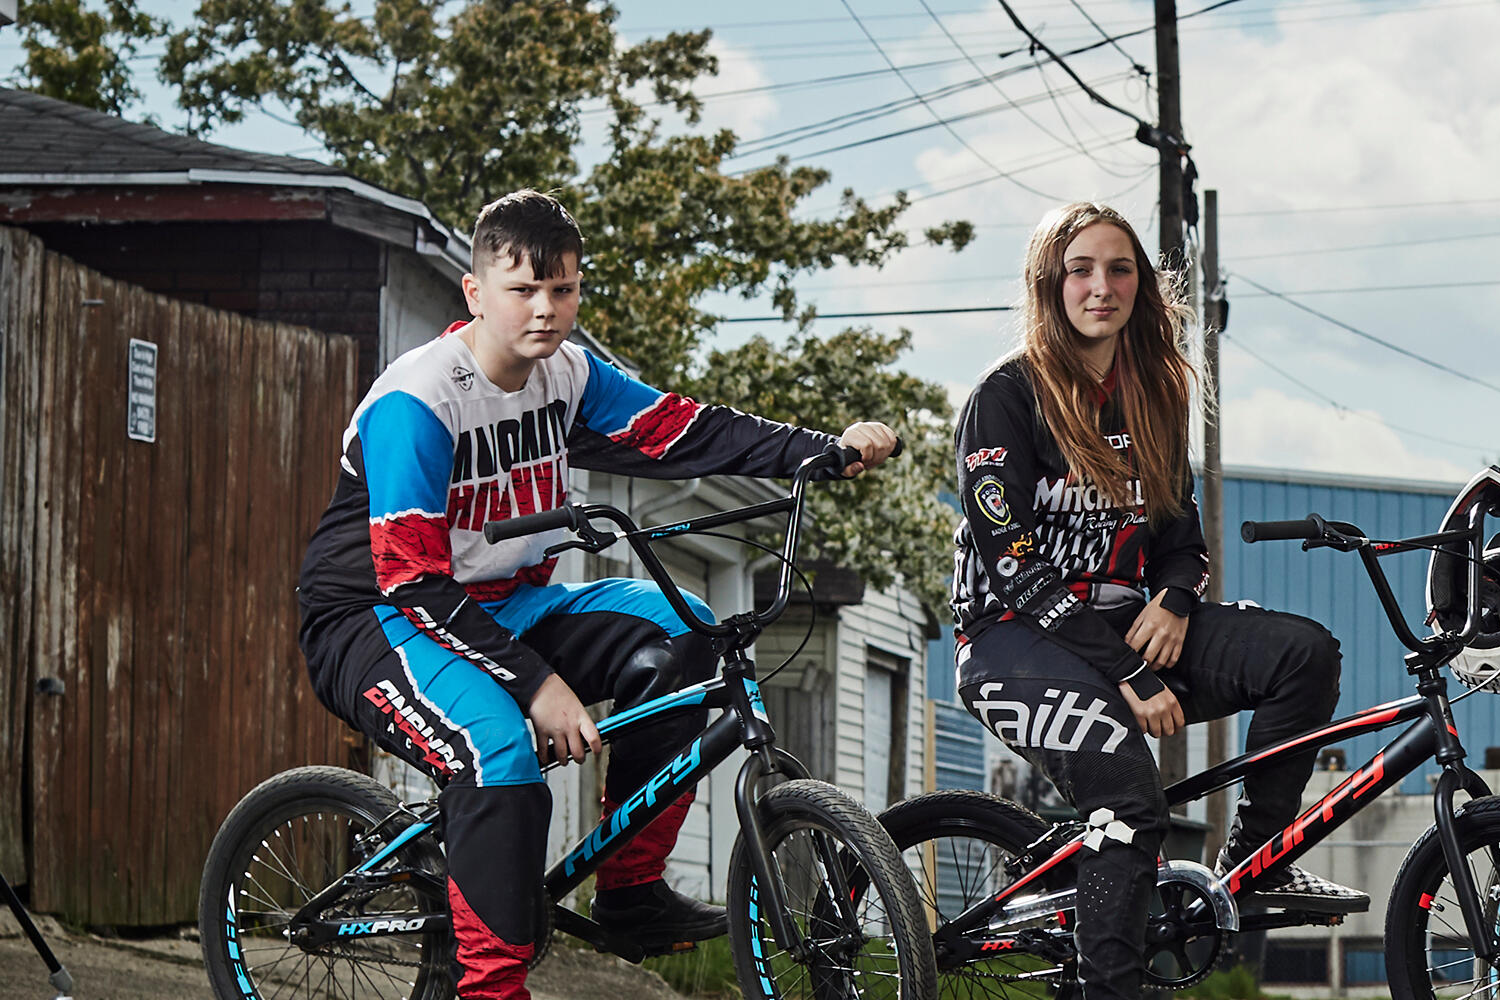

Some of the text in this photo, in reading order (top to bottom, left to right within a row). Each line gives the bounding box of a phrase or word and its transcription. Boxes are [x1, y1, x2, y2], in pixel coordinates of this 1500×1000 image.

[1039, 592, 1079, 628] BIKE
[972, 682, 1129, 754] faith
[564, 737, 702, 878] HUFFY
[1229, 752, 1385, 895] HUFFY
